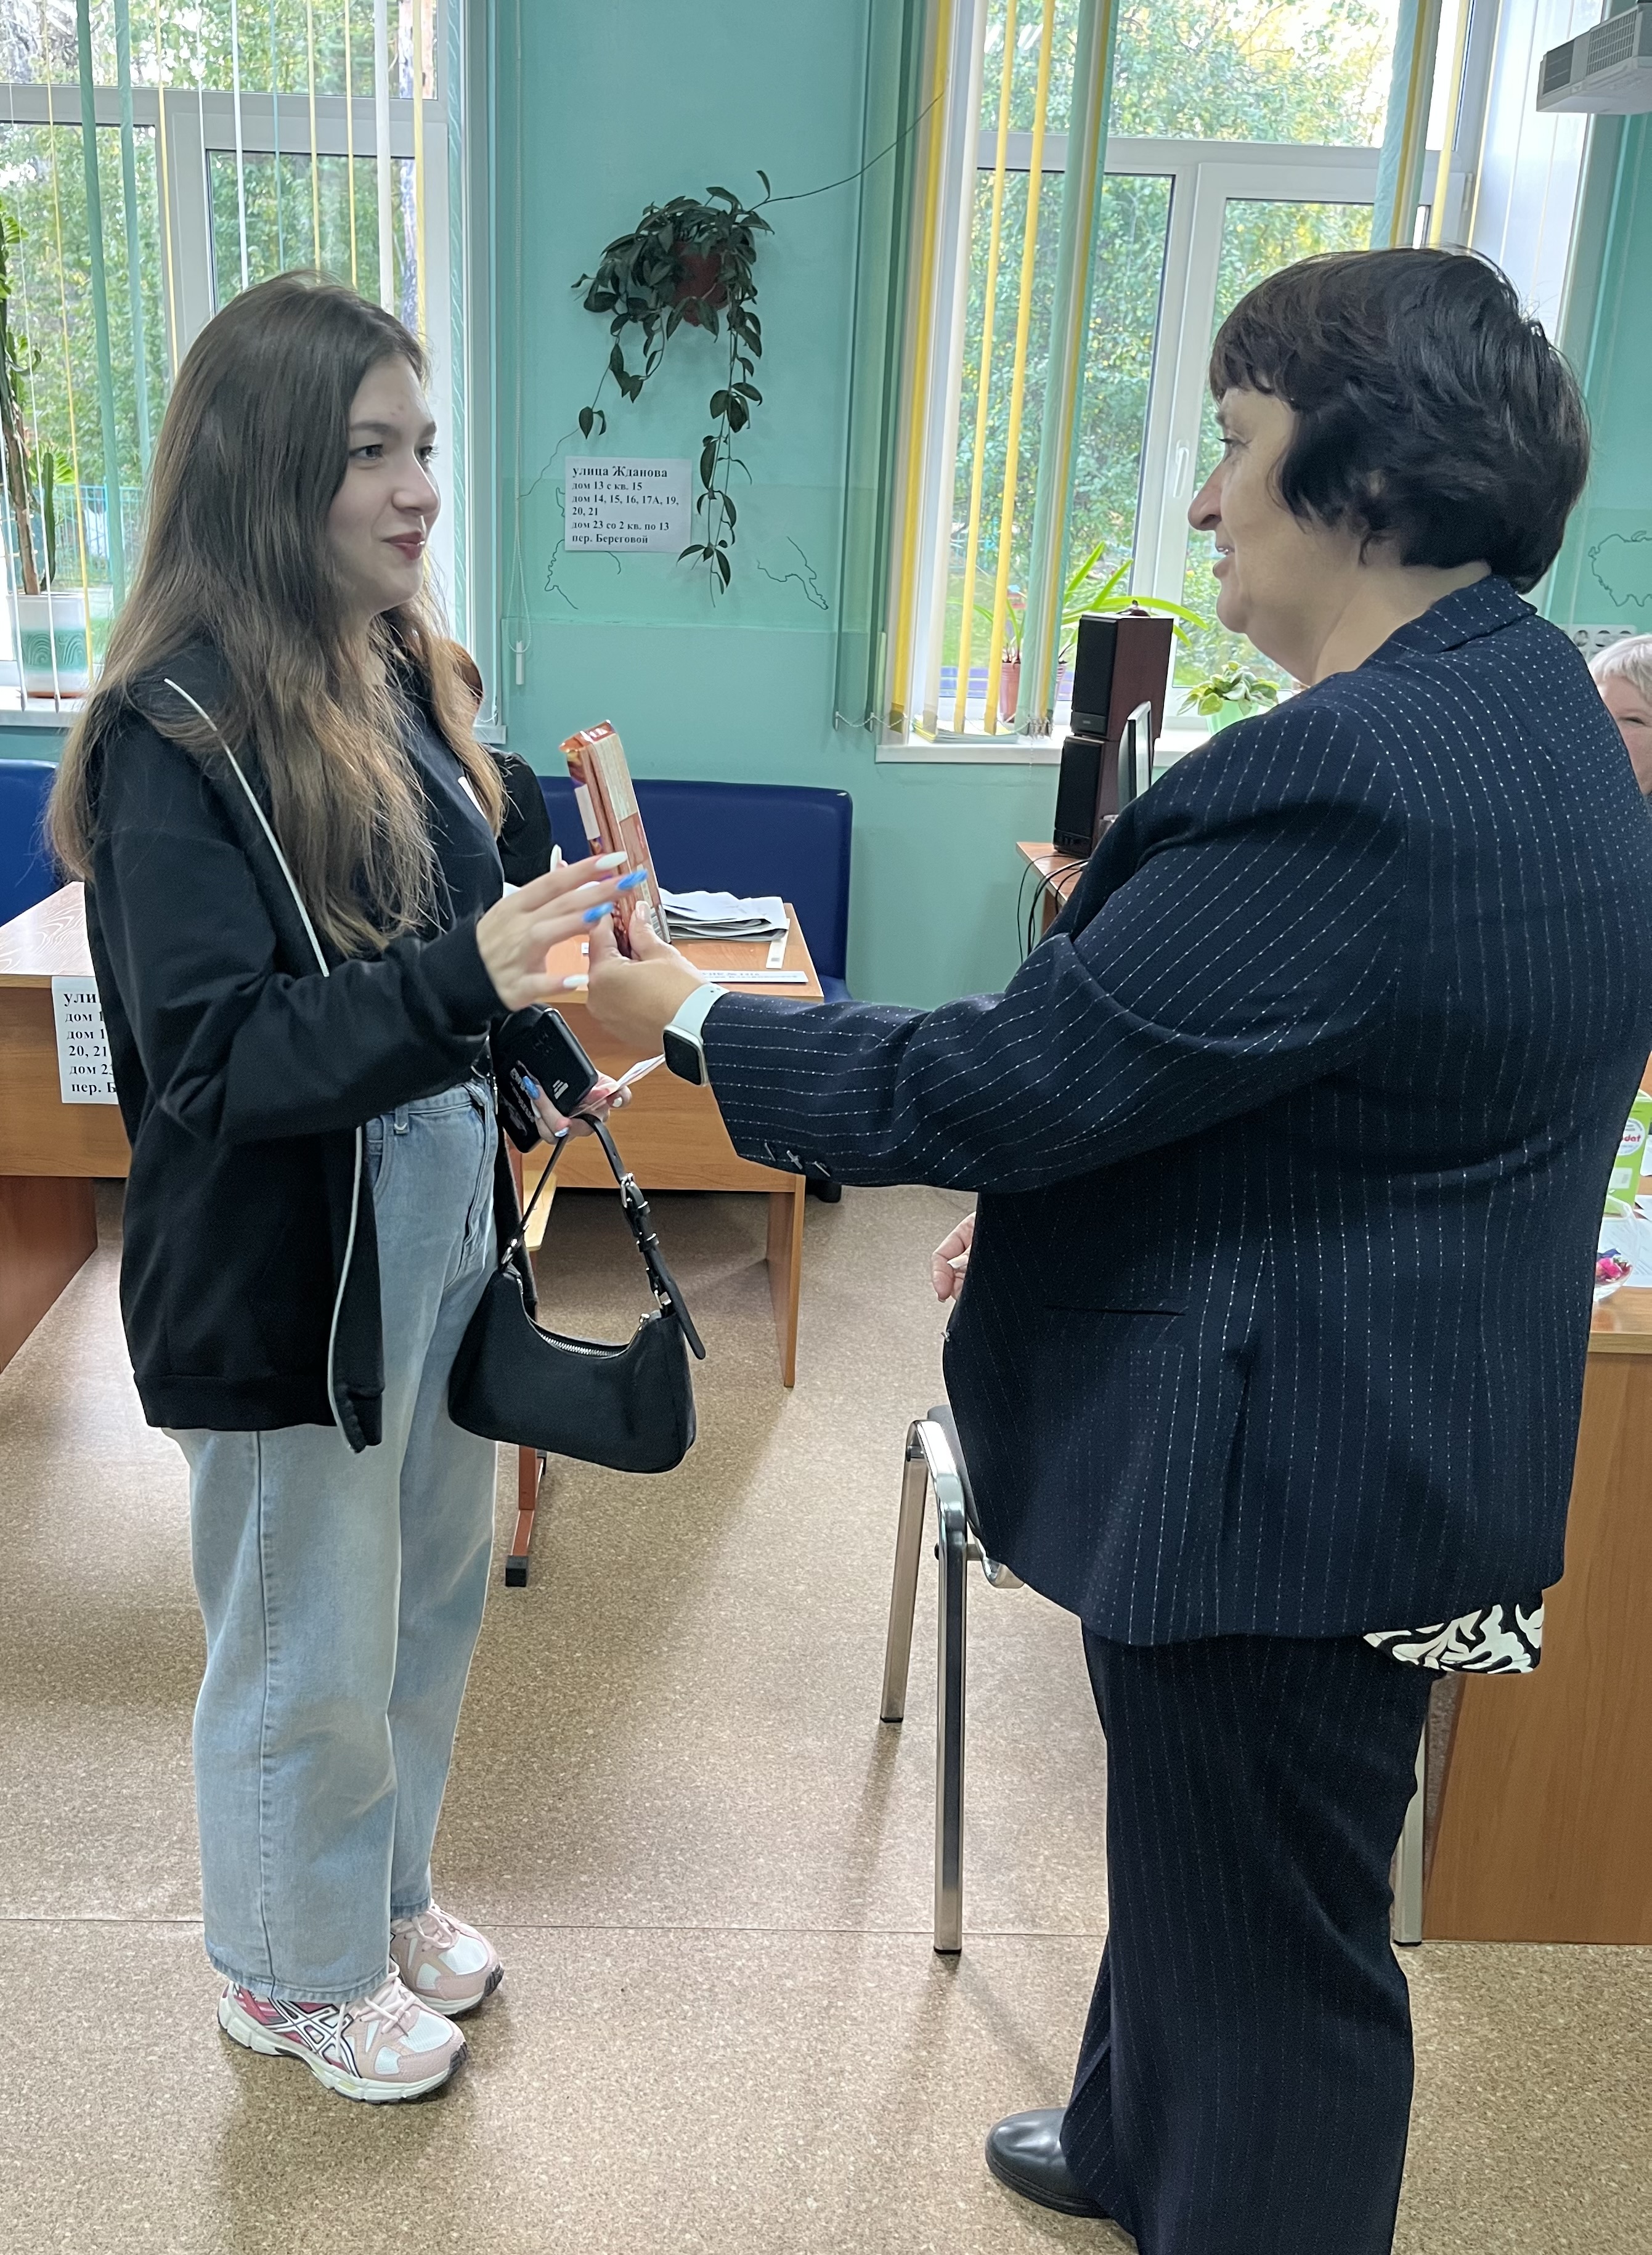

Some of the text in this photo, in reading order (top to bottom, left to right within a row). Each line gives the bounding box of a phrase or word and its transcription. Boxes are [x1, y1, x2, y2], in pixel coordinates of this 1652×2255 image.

[572, 466, 667, 478] улица Жданова
[572, 482, 590, 490] дом
[594, 481, 604, 490] 13
[632, 482, 643, 490] 15
[572, 494, 679, 506] дом 14, 15, 16, 17А, 19,
[572, 507, 598, 516] 20, 21
[572, 521, 590, 529] дом
[593, 520, 603, 529] 23
[619, 521, 624, 530] 2
[659, 522, 670, 531] 13
[572, 534, 648, 545] пер. Береговой
[63, 993, 97, 1007] ули
[65, 1010, 104, 1023] дом 1
[67, 1028, 105, 1040] дом 1
[69, 1045, 107, 1058] 20, 21
[69, 1065, 96, 1075] дом
[71, 1083, 102, 1095] пер.
